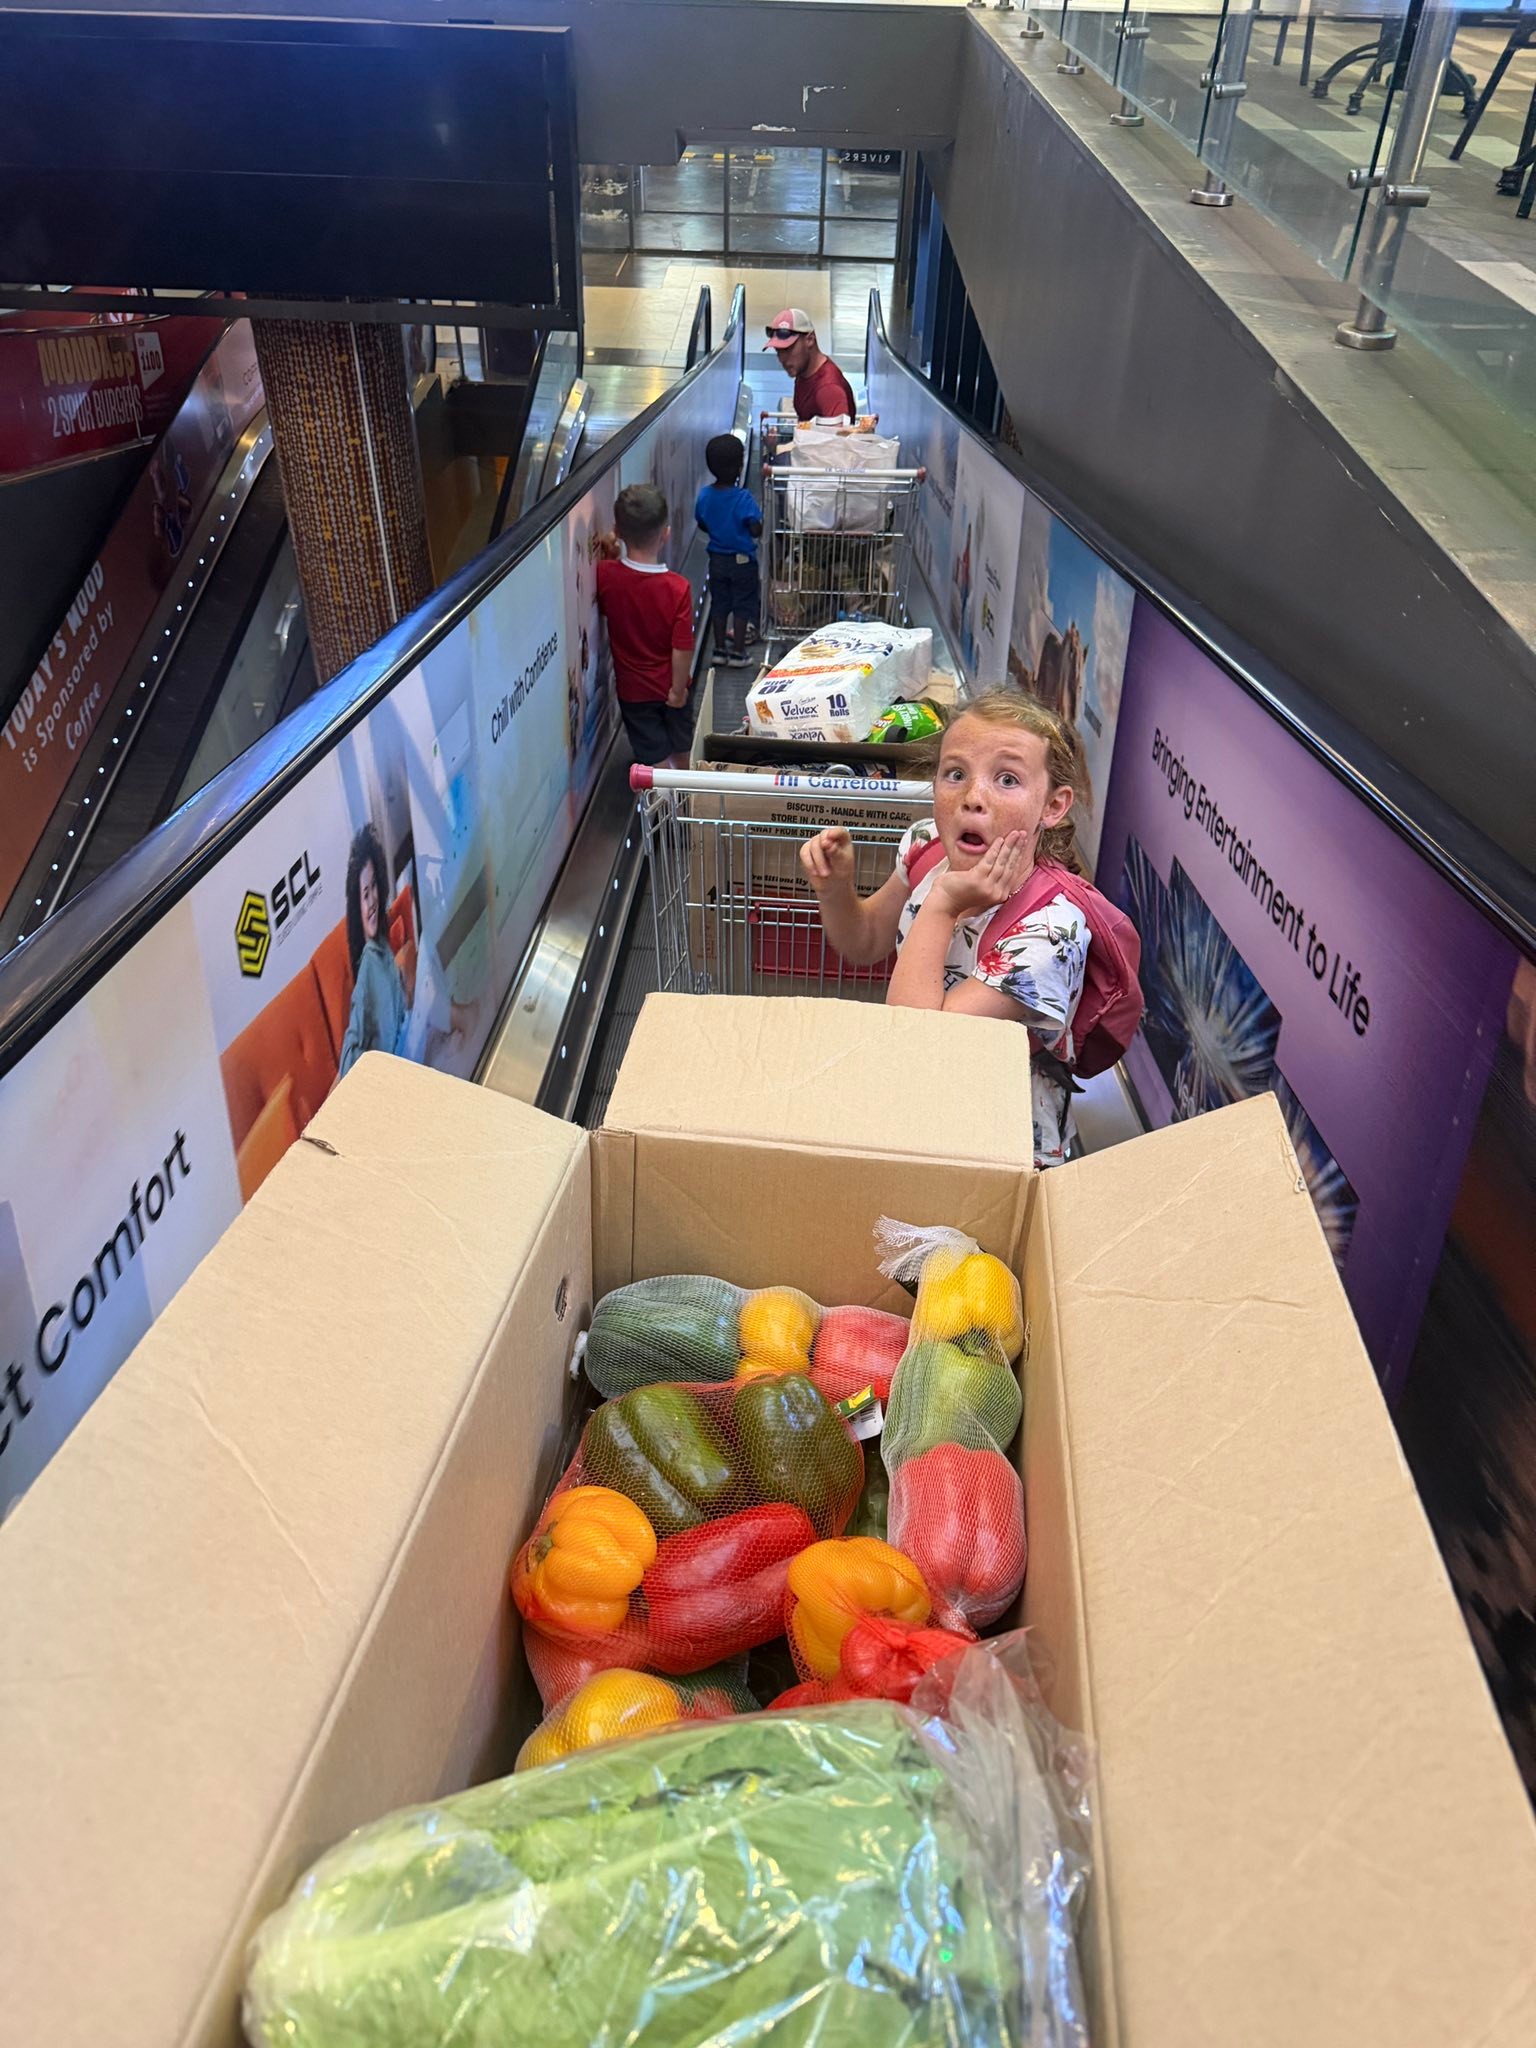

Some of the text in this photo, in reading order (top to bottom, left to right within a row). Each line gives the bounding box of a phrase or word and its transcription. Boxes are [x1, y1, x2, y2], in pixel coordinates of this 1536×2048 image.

[48, 384, 144, 438] 2 SPUR BURGERS
[22, 601, 115, 773] is Sponsored by
[491, 632, 558, 744] Chill with Confidence
[781, 703, 818, 717] Velvex
[826, 693, 848, 709] 10
[829, 707, 850, 718] Rolls
[789, 731, 827, 742] Velvex
[807, 774, 901, 792] Carrefour
[771, 813, 798, 824] STORE
[799, 816, 809, 825] IN
[810, 817, 817, 826] A
[786, 801, 825, 815] BISCUITS
[831, 806, 864, 818] HANDLE
[866, 810, 888, 820] WITH
[889, 812, 912, 822] CARE
[775, 826, 798, 836] FROM
[271, 849, 321, 931] SCL
[1152, 727, 1370, 1036] Bringing Entertainment to Life
[37, 1128, 192, 1377] Comfort
